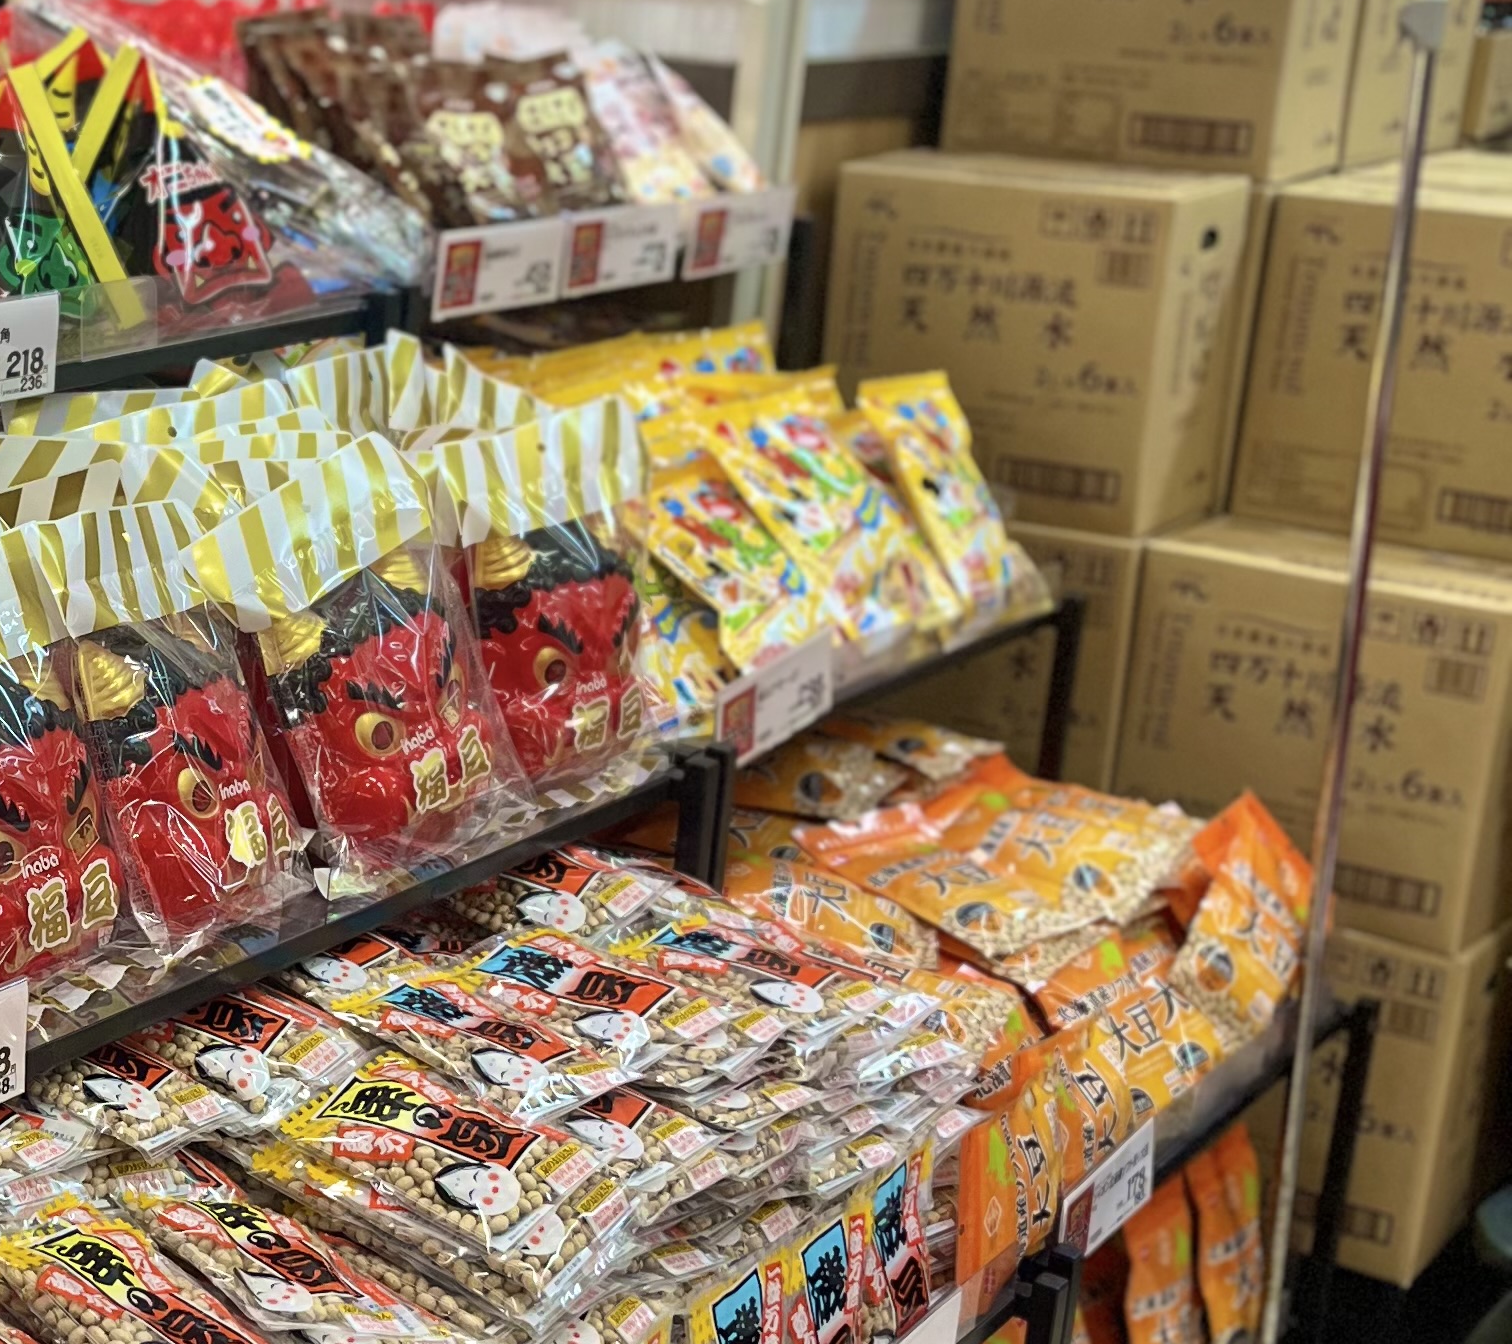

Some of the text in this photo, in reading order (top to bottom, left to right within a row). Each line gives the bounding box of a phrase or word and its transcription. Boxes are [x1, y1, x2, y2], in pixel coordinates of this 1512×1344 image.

[6, 347, 44, 379] 218
[20, 374, 43, 392] 236
[575, 675, 609, 698] inaba
[571, 690, 646, 752] 福豆
[401, 723, 435, 755] inaba
[410, 727, 491, 813] 福豆
[220, 777, 251, 800] inaba
[225, 793, 291, 869] 福豆
[20, 852, 60, 879] inaba
[27, 859, 120, 953] 福豆
[1106, 998, 1164, 1062] 大豆
